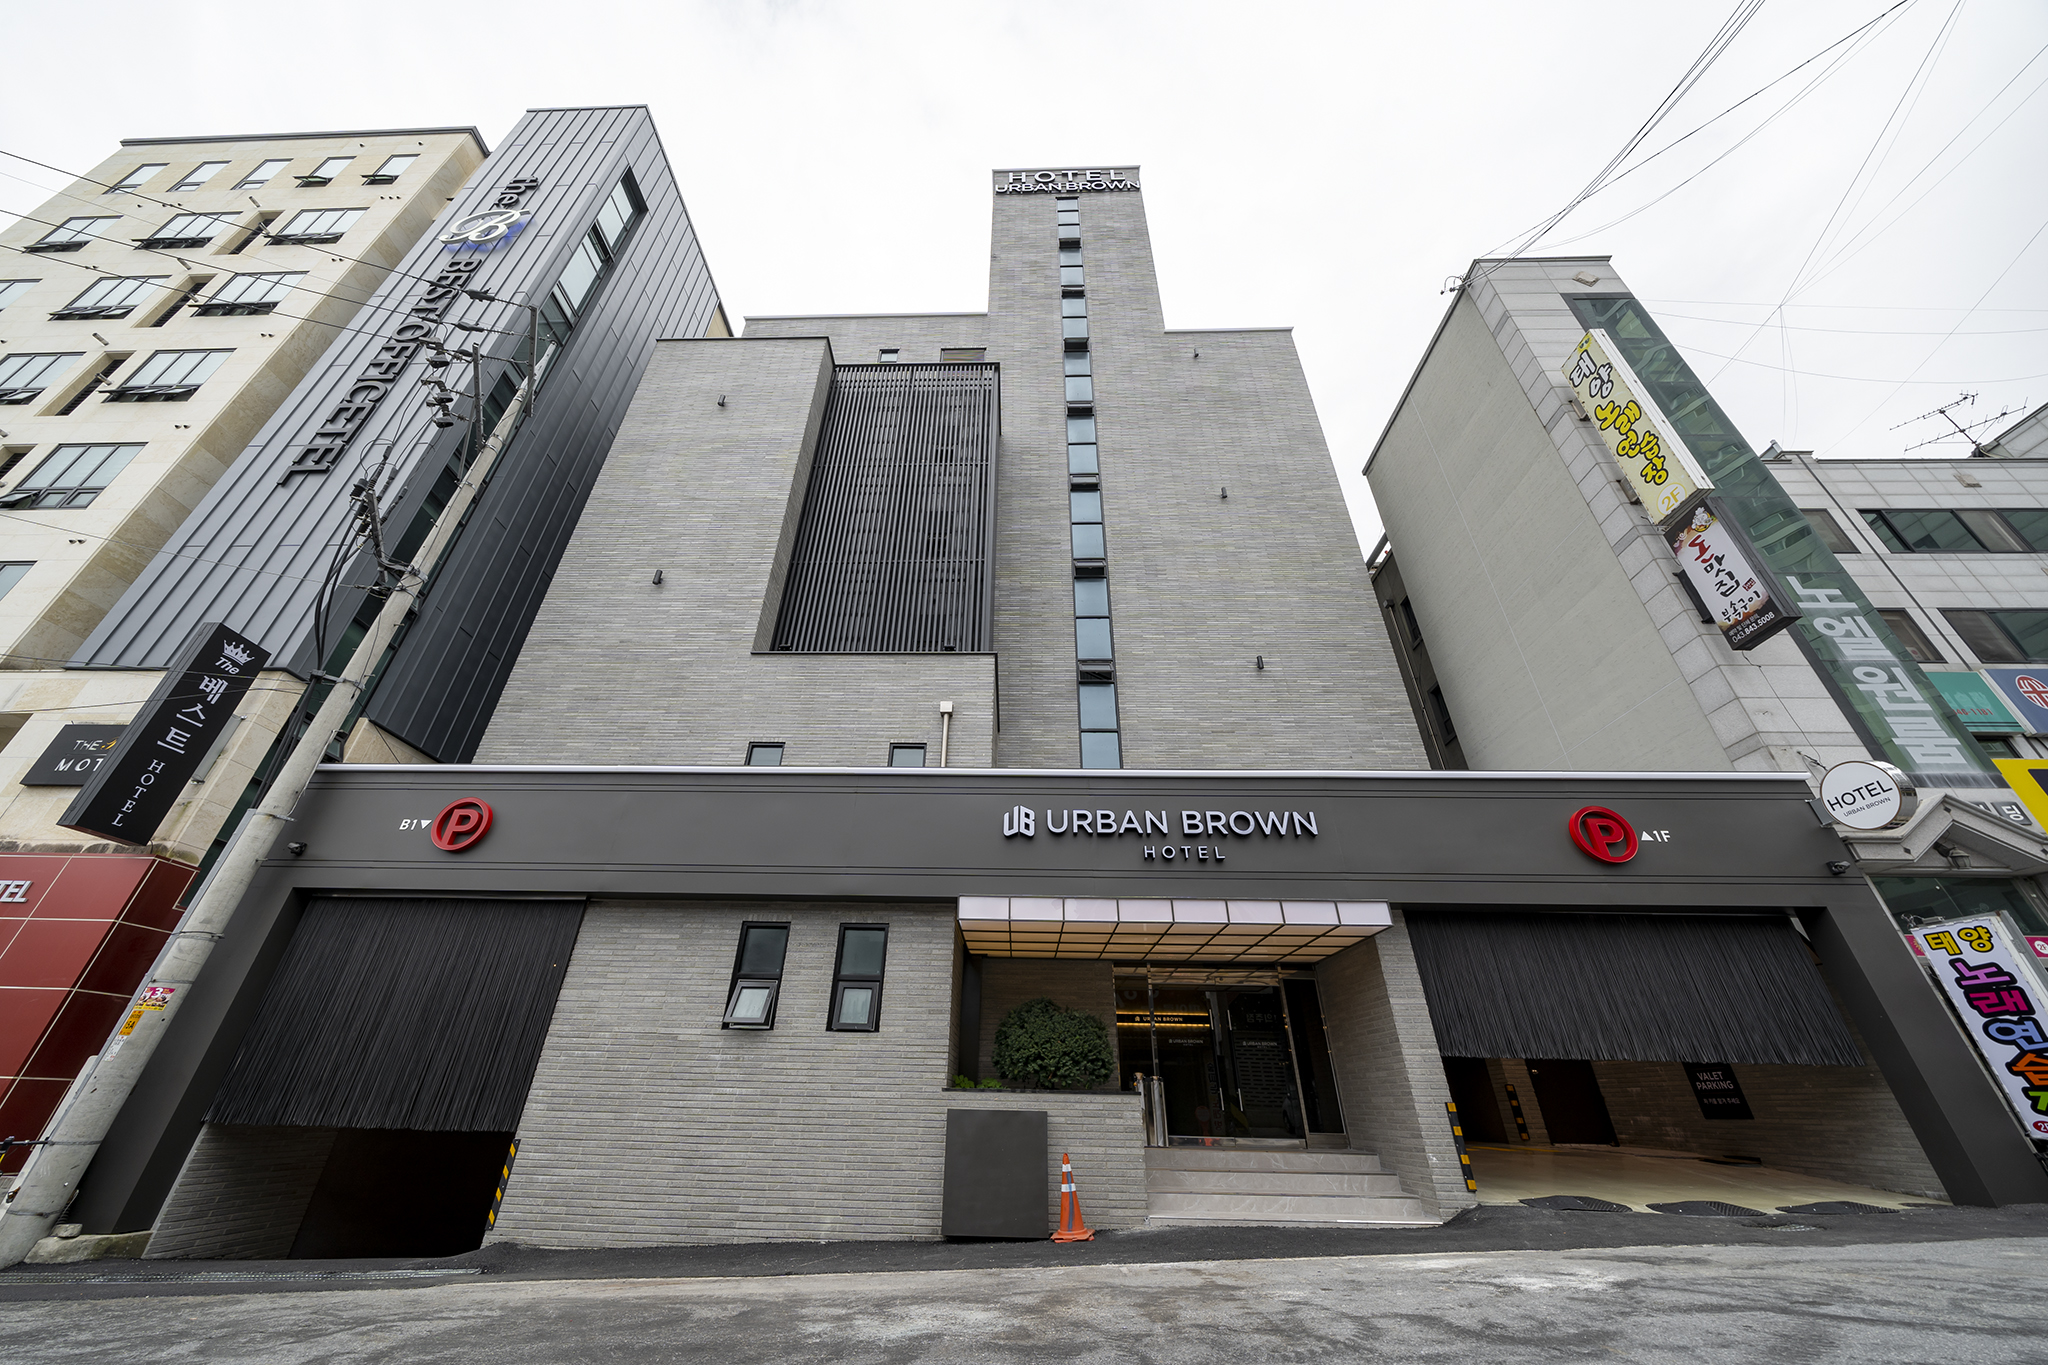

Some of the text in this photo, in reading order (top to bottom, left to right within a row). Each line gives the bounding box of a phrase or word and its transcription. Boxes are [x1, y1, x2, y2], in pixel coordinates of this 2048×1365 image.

[995, 180, 1140, 192] URBAN BROWN
[1009, 169, 1125, 183] HOTEL
[495, 176, 539, 209] the
[277, 257, 482, 487] BEST OFFICETEL
[1569, 349, 1669, 485] 태양 노래연습장
[1661, 486, 1682, 512] 2F
[1721, 590, 1761, 623] 부속구이
[1732, 611, 1775, 643] 043.843.5008
[215, 656, 240, 675] The
[1786, 575, 1969, 764] 노엘원룸
[157, 675, 229, 754] 베스트
[73, 740, 103, 751] THE
[112, 759, 166, 827] HOTEL
[1827, 780, 1893, 812] HOTEL
[1843, 796, 1891, 818] URBAN BROWN
[399, 819, 418, 830] B1
[1047, 809, 1169, 835] URBAN
[1181, 810, 1319, 837] BROWN
[1653, 830, 1671, 842] 1F
[1144, 846, 1226, 860] HOTEL
[1923, 926, 1994, 956] 태양
[1696, 1081, 1734, 1090] PARKING
[1697, 1071, 1723, 1081] VALET
